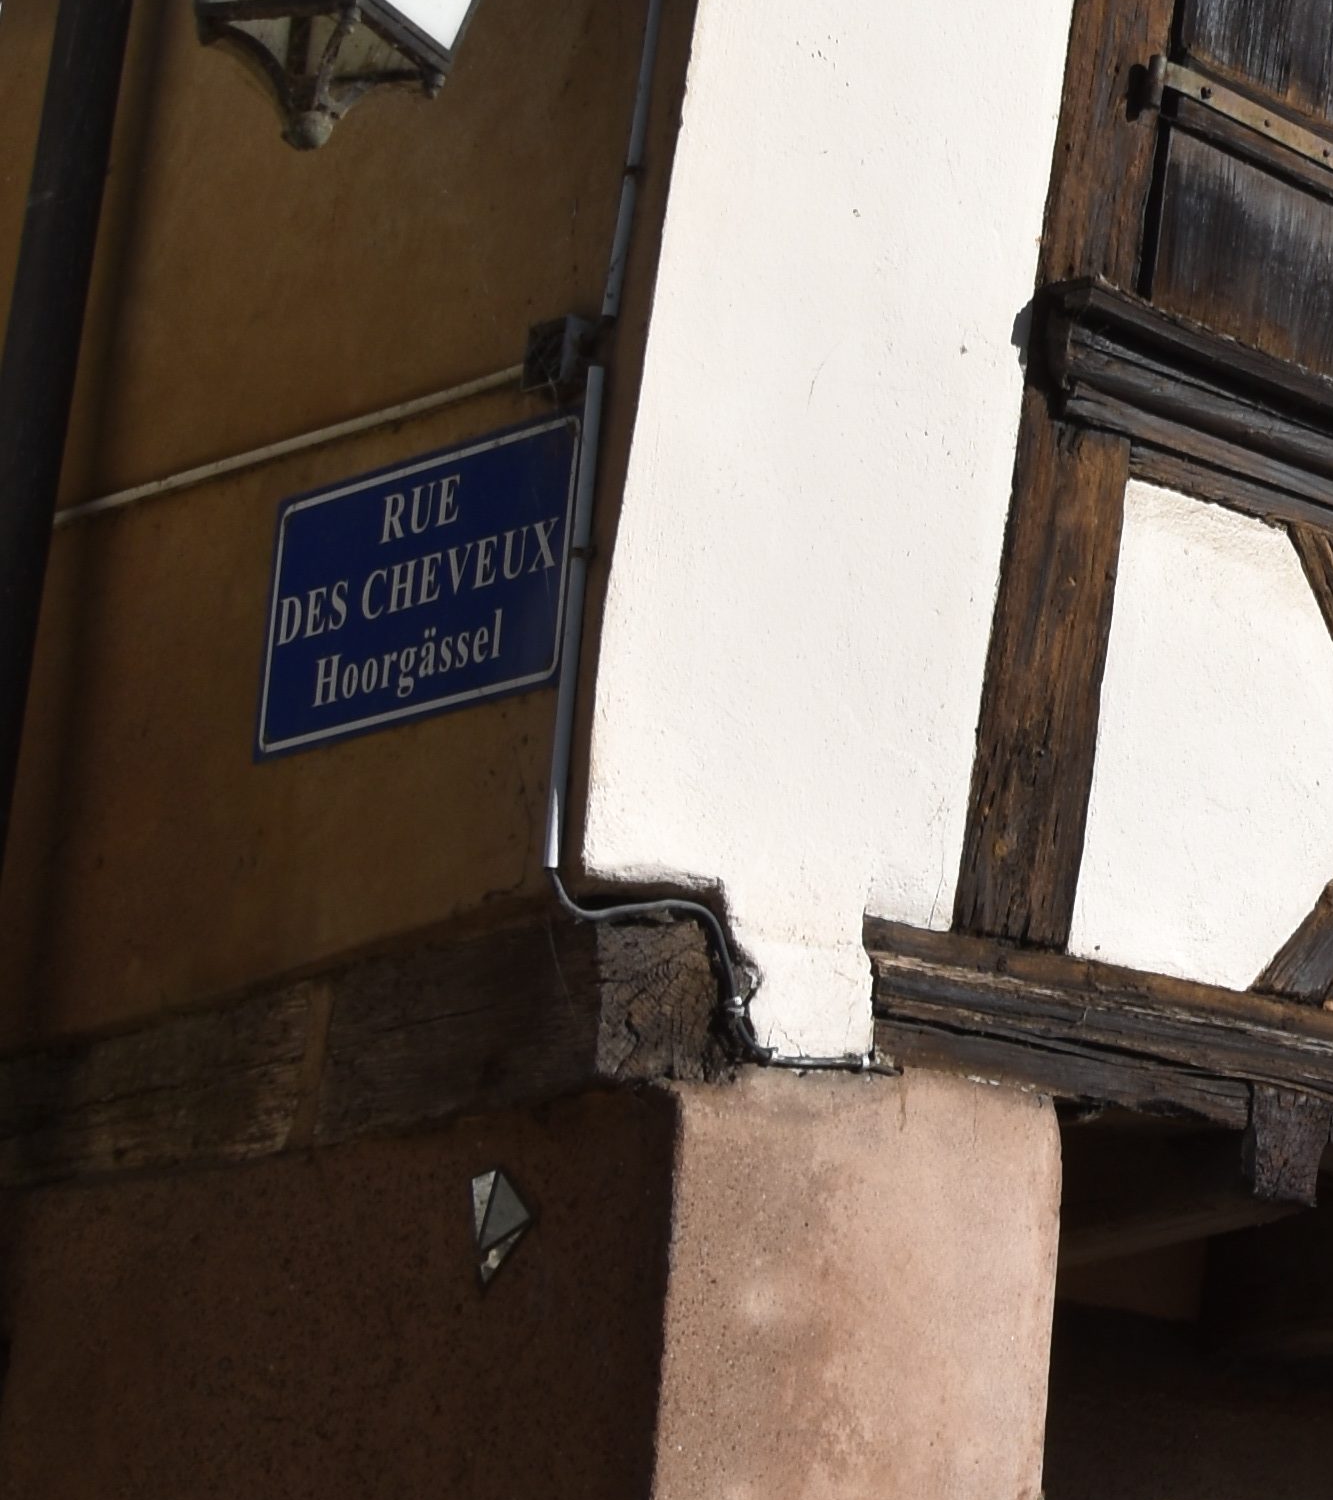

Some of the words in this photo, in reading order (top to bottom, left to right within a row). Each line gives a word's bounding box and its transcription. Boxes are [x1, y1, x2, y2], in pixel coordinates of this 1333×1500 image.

[379, 474, 461, 544] RUE
[276, 581, 348, 647] DES
[362, 517, 560, 621] CHEVEUX
[312, 609, 503, 708] Hoorgässel
